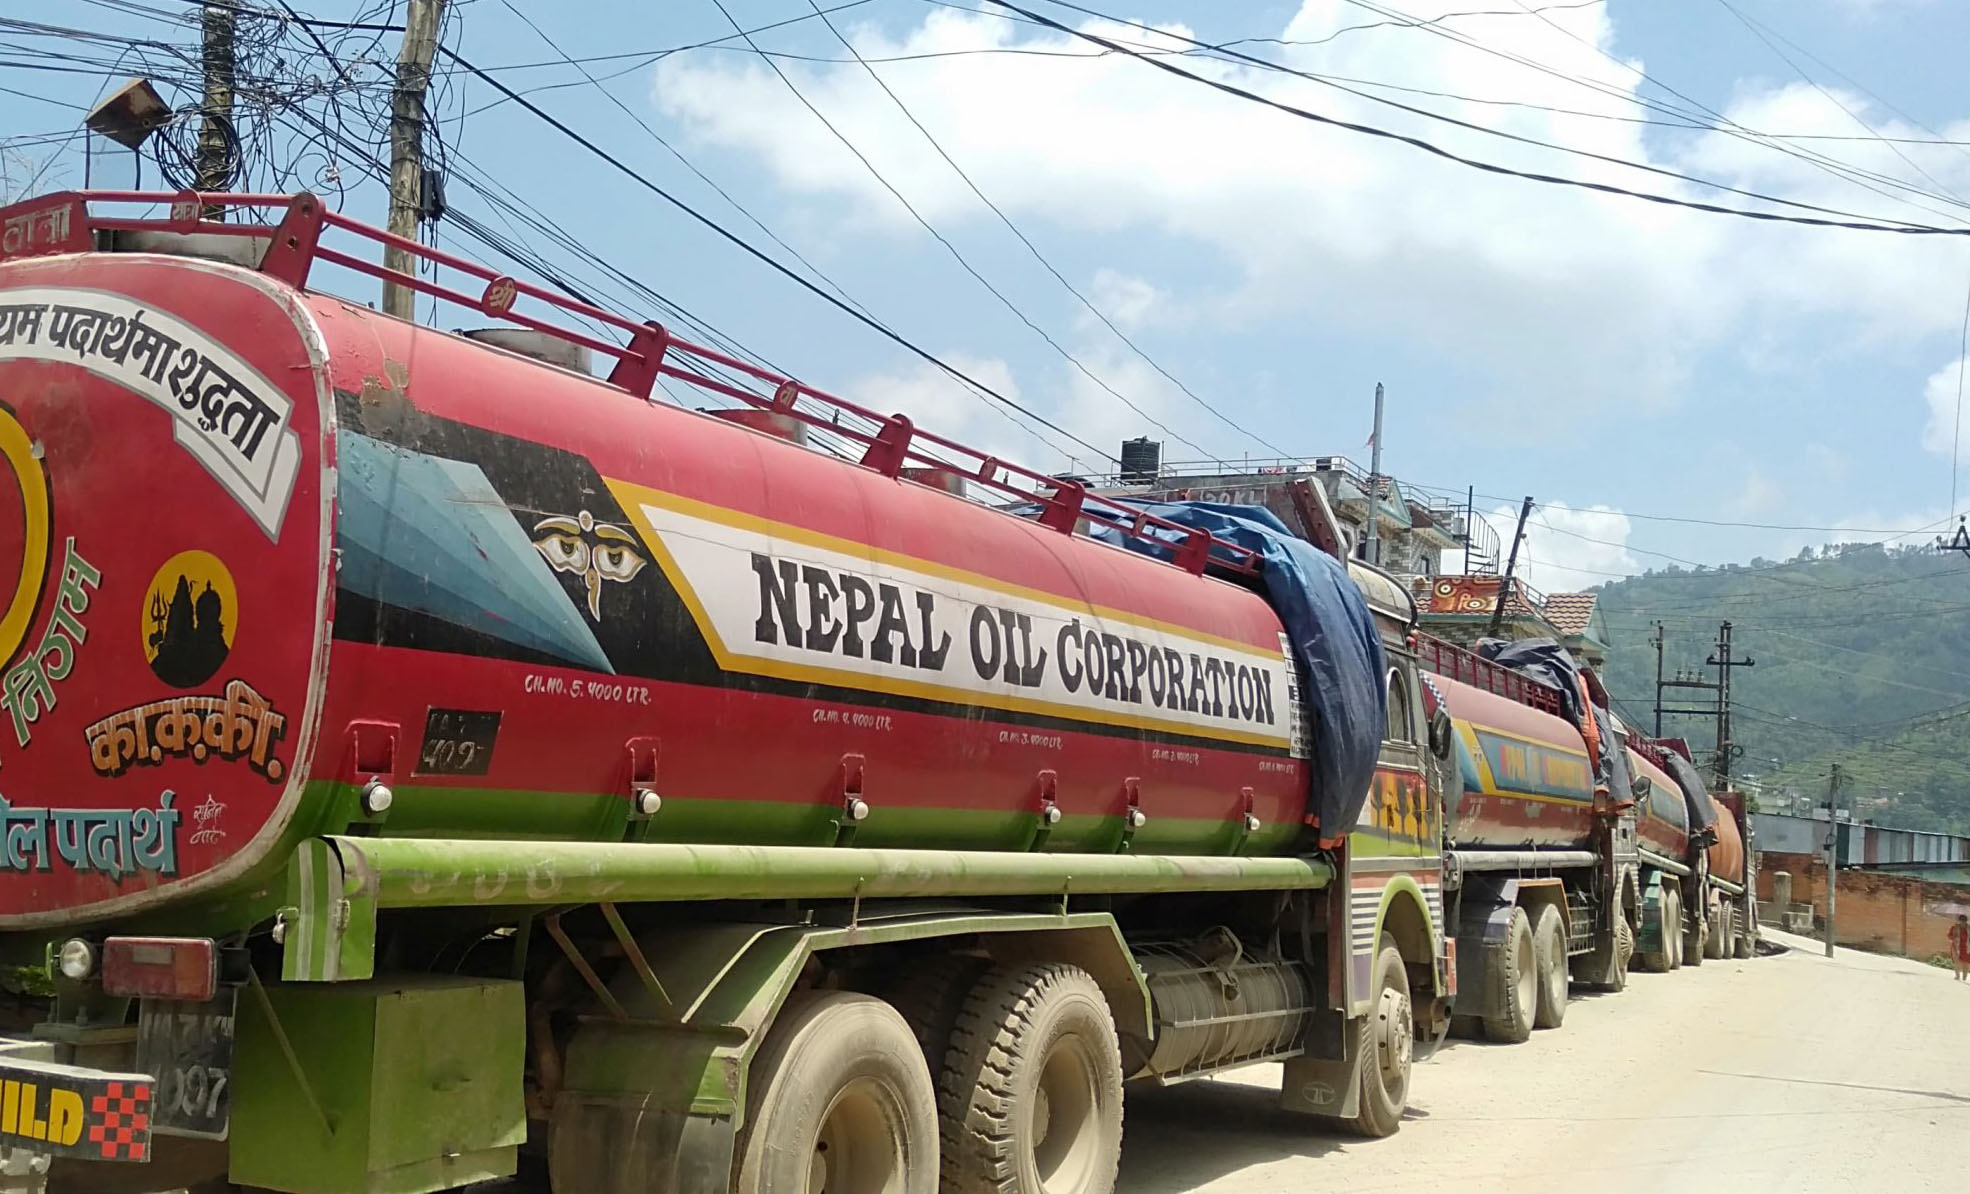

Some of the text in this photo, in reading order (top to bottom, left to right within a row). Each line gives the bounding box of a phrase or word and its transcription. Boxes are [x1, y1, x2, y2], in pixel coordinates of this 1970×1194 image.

[0, 536, 101, 747] निगम
[751, 552, 952, 671] NEPAL
[970, 605, 1047, 687] OIL
[1057, 617, 1275, 725] CORPORATION
[587, 682, 622, 701] 4000
[50, 789, 178, 884] पदार्थ
[0, 1079, 84, 1146] ILD
